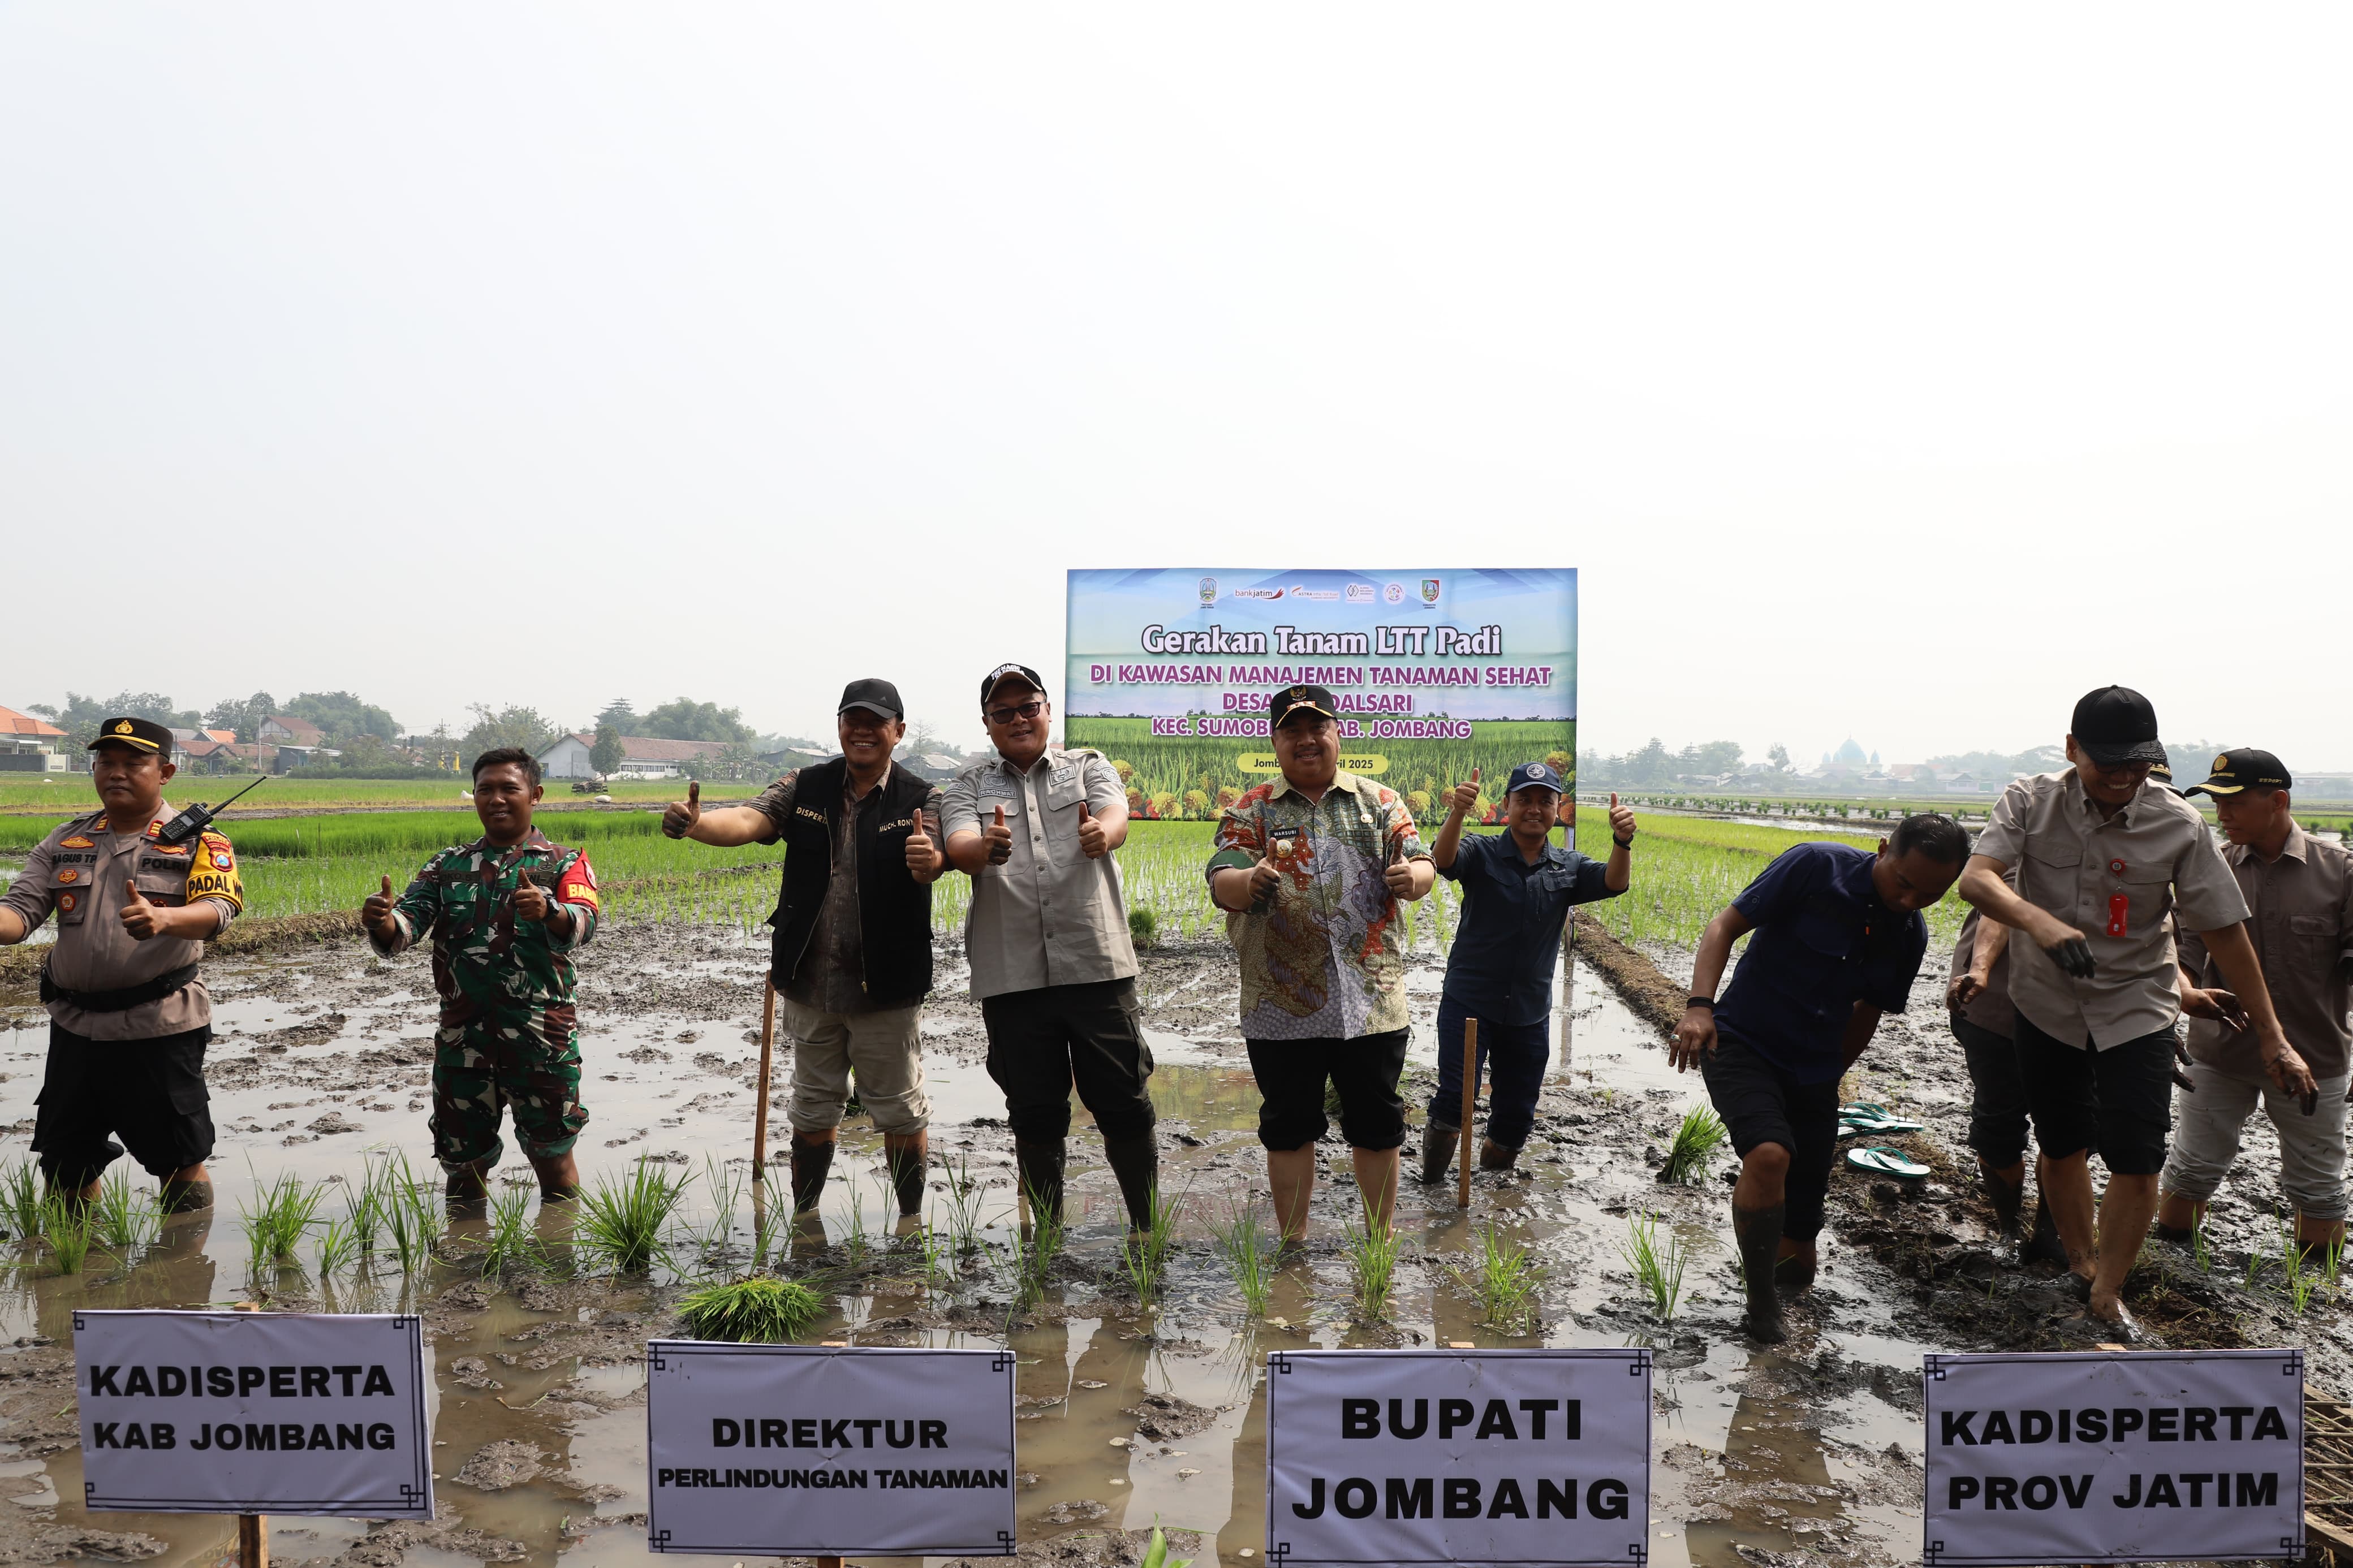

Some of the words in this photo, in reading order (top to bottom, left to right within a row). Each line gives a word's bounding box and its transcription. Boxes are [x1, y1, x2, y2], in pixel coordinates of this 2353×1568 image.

[1235, 589, 1273, 598] bankjatim
[1141, 624, 1268, 654] Gerakan
[1273, 626, 1369, 655] Tanam
[1375, 626, 1429, 655] LTT
[1435, 625, 1502, 655] Padi
[1091, 665, 1111, 682] DI
[1119, 664, 1222, 683] KAWASAN
[1229, 666, 1363, 684] MANAJEMEN
[1370, 667, 1479, 685] TANAMAN
[1485, 667, 1551, 685] SEHAT
[1223, 693, 1273, 710] DESA
[1331, 694, 1412, 712] DALSARI
[1153, 719, 1193, 735] KEC.
[1198, 719, 1273, 736] SUMOBI
[1338, 720, 1365, 737] AB.
[1371, 721, 1471, 737] JOMBANG
[1254, 758, 1281, 767] Jomb
[1348, 760, 1373, 769] 2025
[142, 858, 187, 871] POLRI
[188, 875, 230, 897] PADAL
[90, 1366, 395, 1397] KADISPERTA
[1342, 1398, 1581, 1440] BUPATI
[1941, 1406, 2289, 1446] KADISPERTA
[93, 1422, 176, 1449] KAB
[190, 1423, 395, 1450] JOMBANG
[713, 1418, 949, 1448] DIREKTUR
[658, 1468, 868, 1489] PERLINDUNGAN
[874, 1469, 1008, 1489] TANAMAN
[1949, 1474, 2095, 1510] PROV
[2113, 1472, 2278, 1509] JATIM
[1292, 1478, 1629, 1520] JOMBANG
